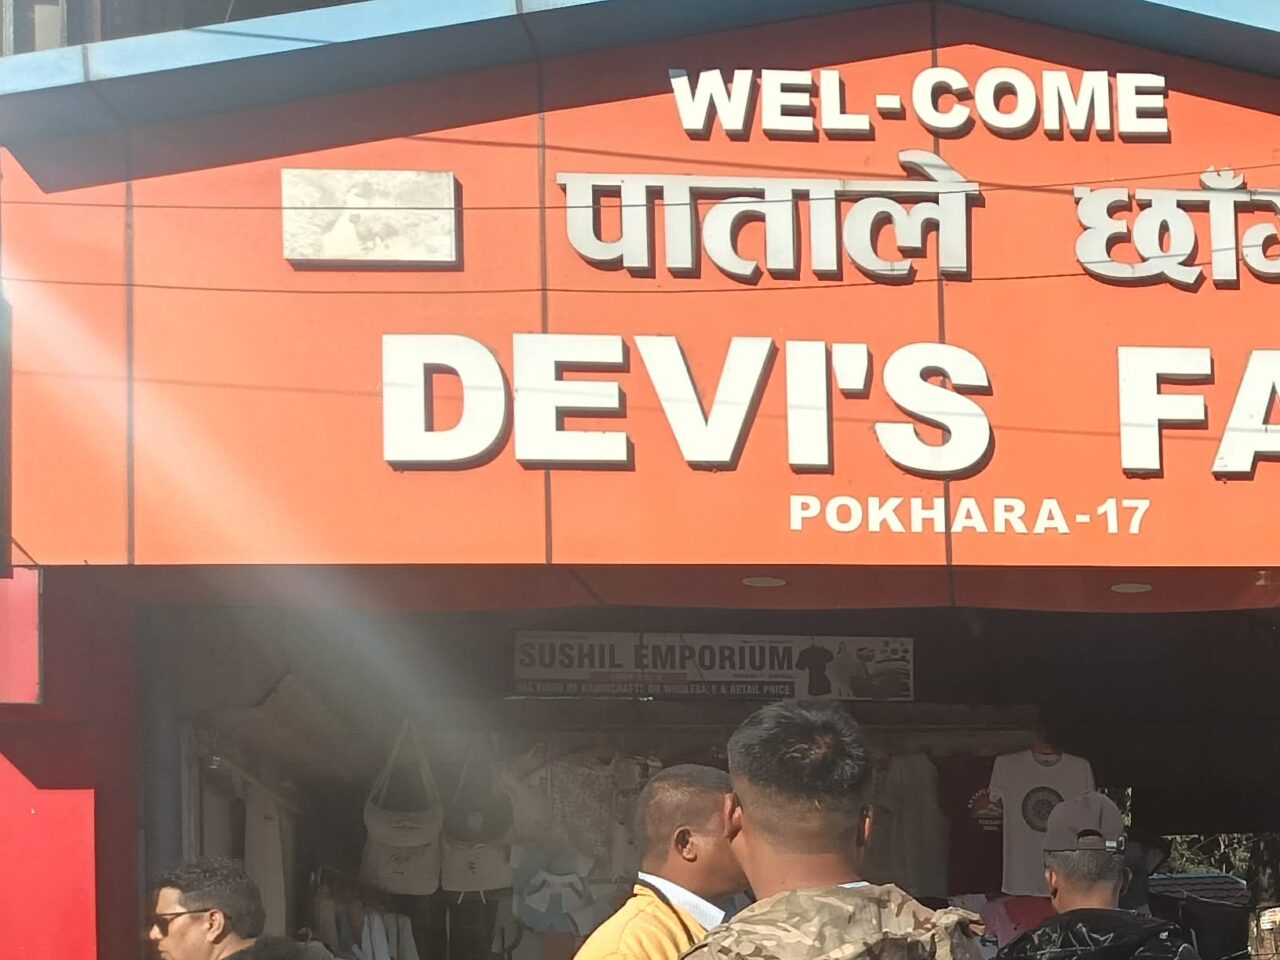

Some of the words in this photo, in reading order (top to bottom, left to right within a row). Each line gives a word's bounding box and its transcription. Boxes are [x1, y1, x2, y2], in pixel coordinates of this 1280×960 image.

[668, 66, 1171, 139] WEL-COME
[555, 148, 982, 284] पाताले
[381, 332, 993, 475] DEVI'S
[788, 494, 1152, 535] POKHARA-17
[519, 641, 623, 669] SUSHIL
[633, 643, 794, 672] EMPORIUM
